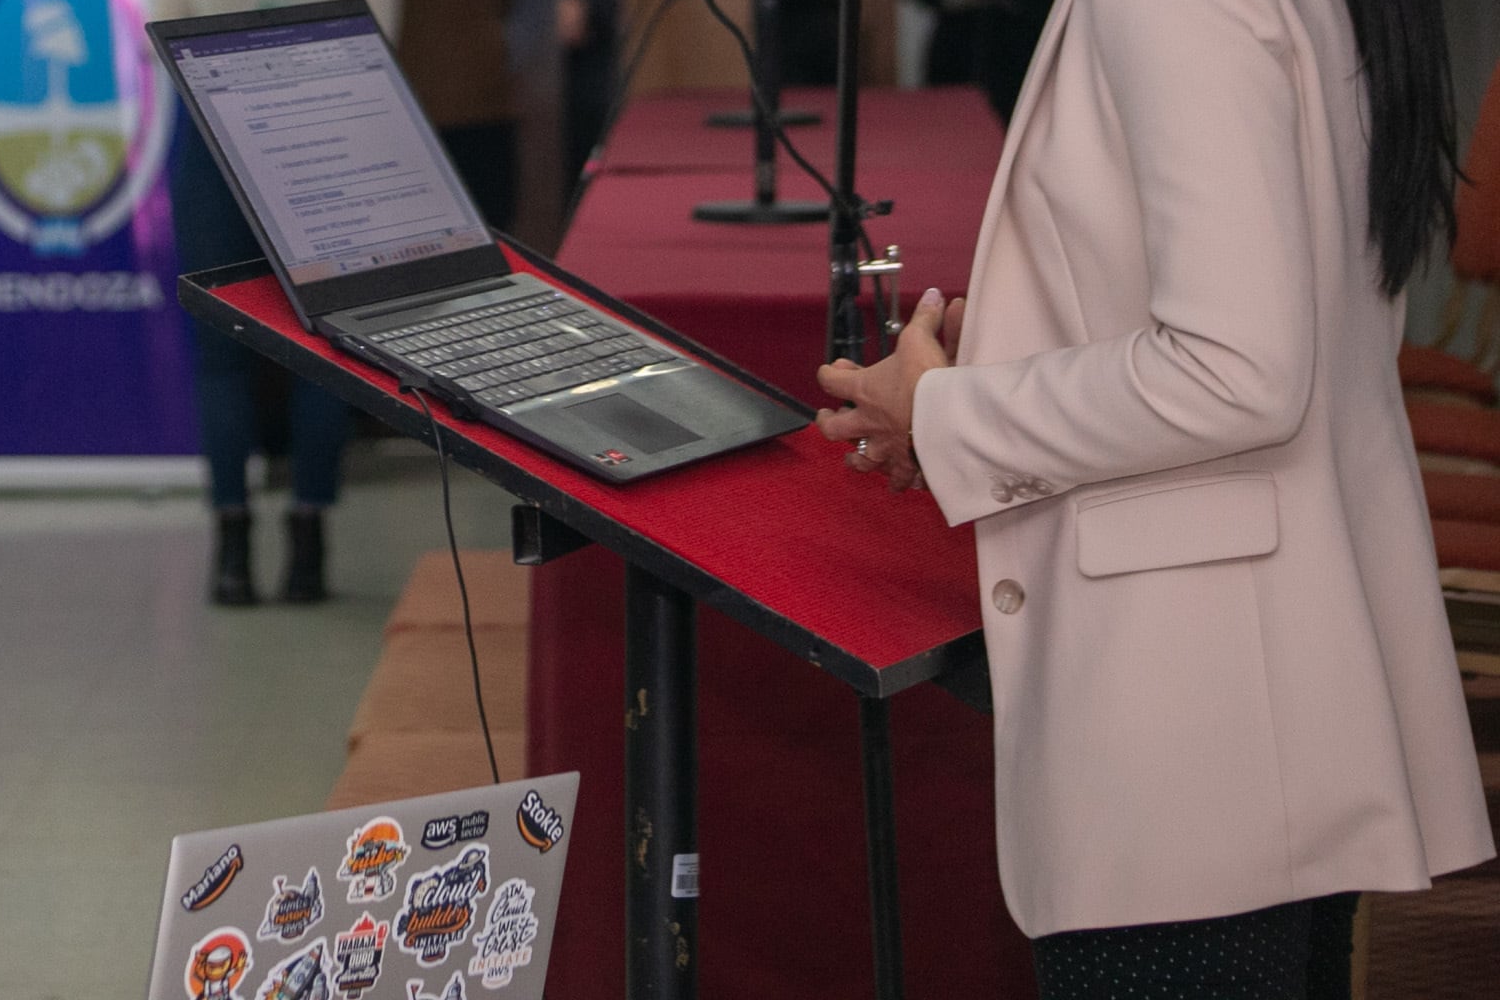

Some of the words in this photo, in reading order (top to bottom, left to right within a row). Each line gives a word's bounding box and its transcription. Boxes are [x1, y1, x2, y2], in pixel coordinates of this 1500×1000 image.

[427, 818, 457, 838] aws
[462, 813, 486, 828] public
[461, 823, 485, 838] sector
[522, 791, 563, 842] Stokle
[183, 846, 238, 909] Mariano
